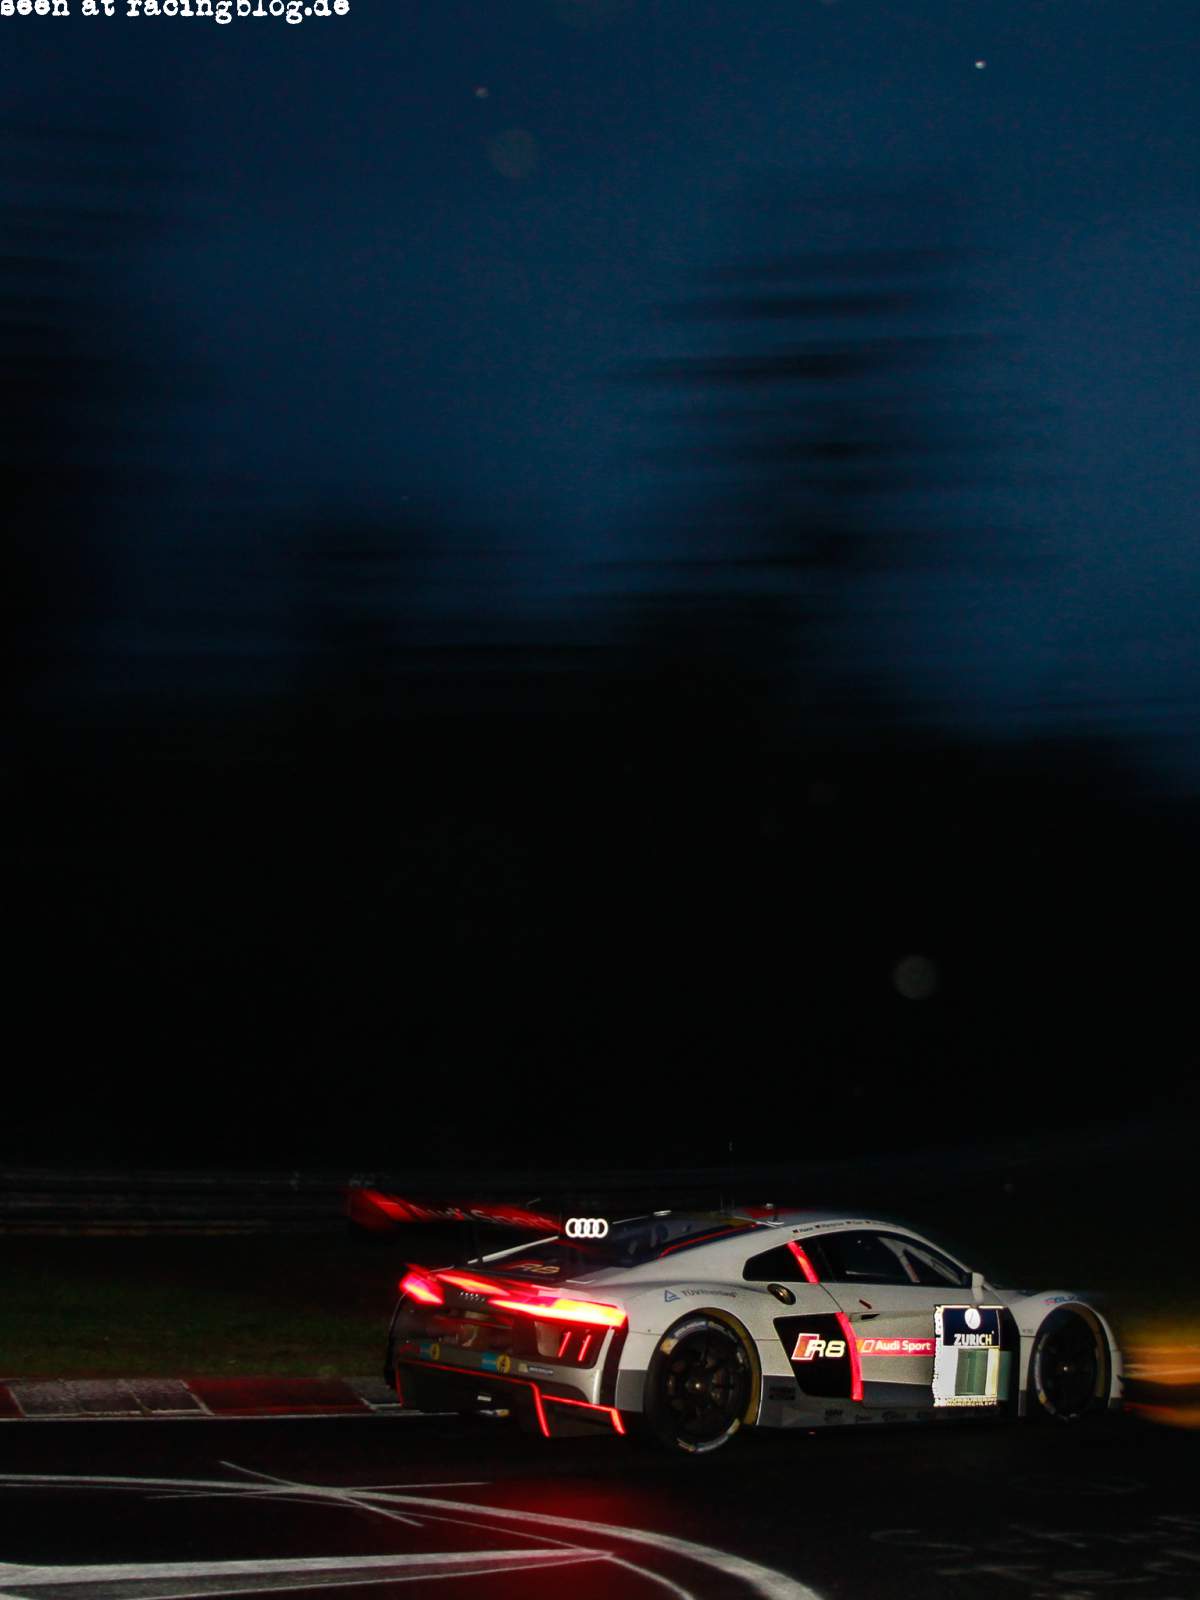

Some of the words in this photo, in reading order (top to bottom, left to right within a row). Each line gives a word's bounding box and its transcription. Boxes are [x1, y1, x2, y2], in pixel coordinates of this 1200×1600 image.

[875, 1340, 899, 1351] Audi
[901, 1340, 931, 1352] Sport
[953, 1333, 993, 1346] ZURICH
[804, 1339, 846, 1358] R8
